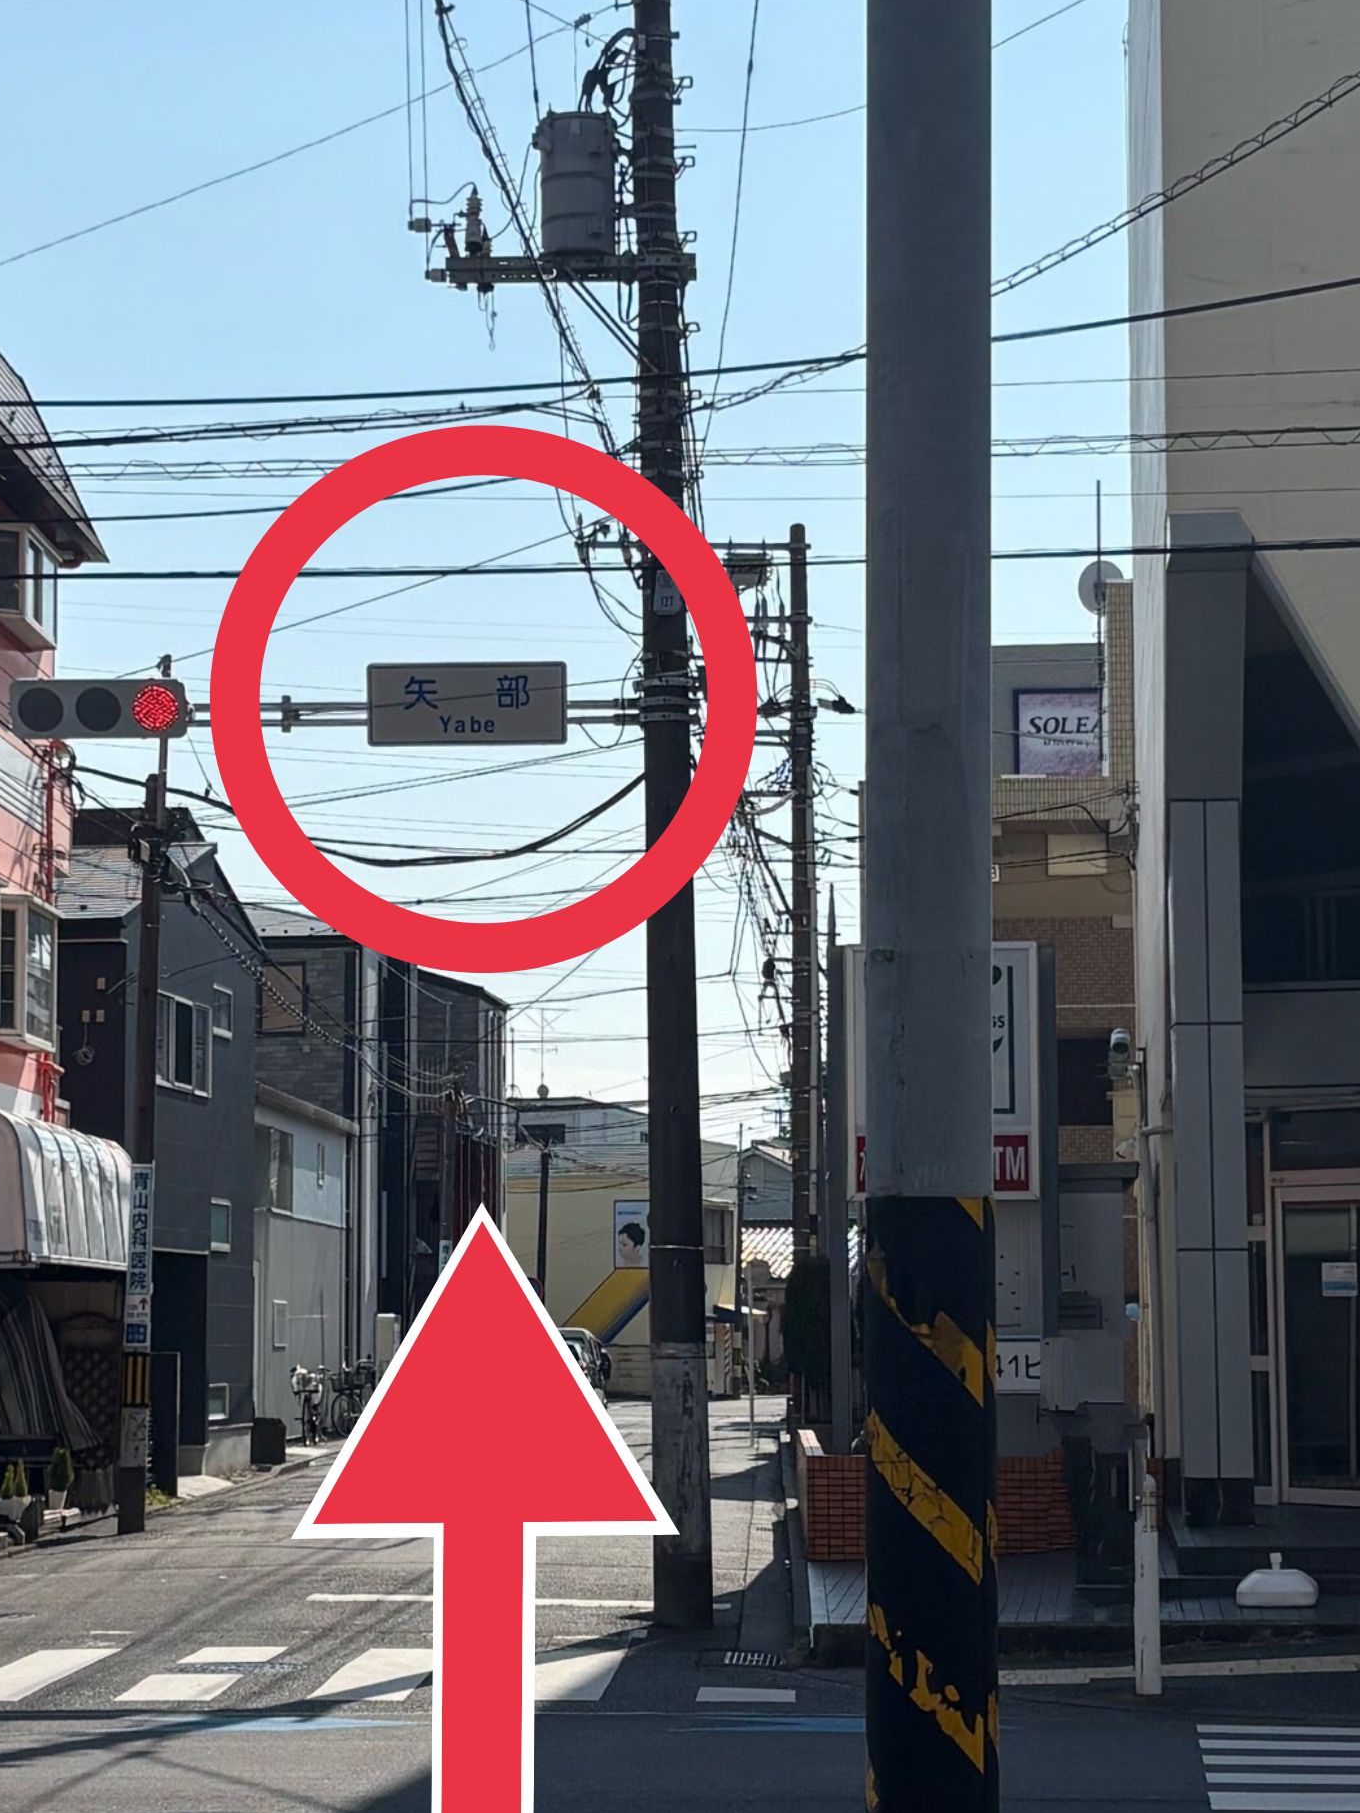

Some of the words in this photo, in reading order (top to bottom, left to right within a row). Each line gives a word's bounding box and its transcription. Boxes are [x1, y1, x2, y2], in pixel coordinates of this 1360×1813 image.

[403, 675, 530, 710] 矢部
[439, 715, 496, 734] Yabe
[131, 1171, 151, 1290] 青山内科医院
